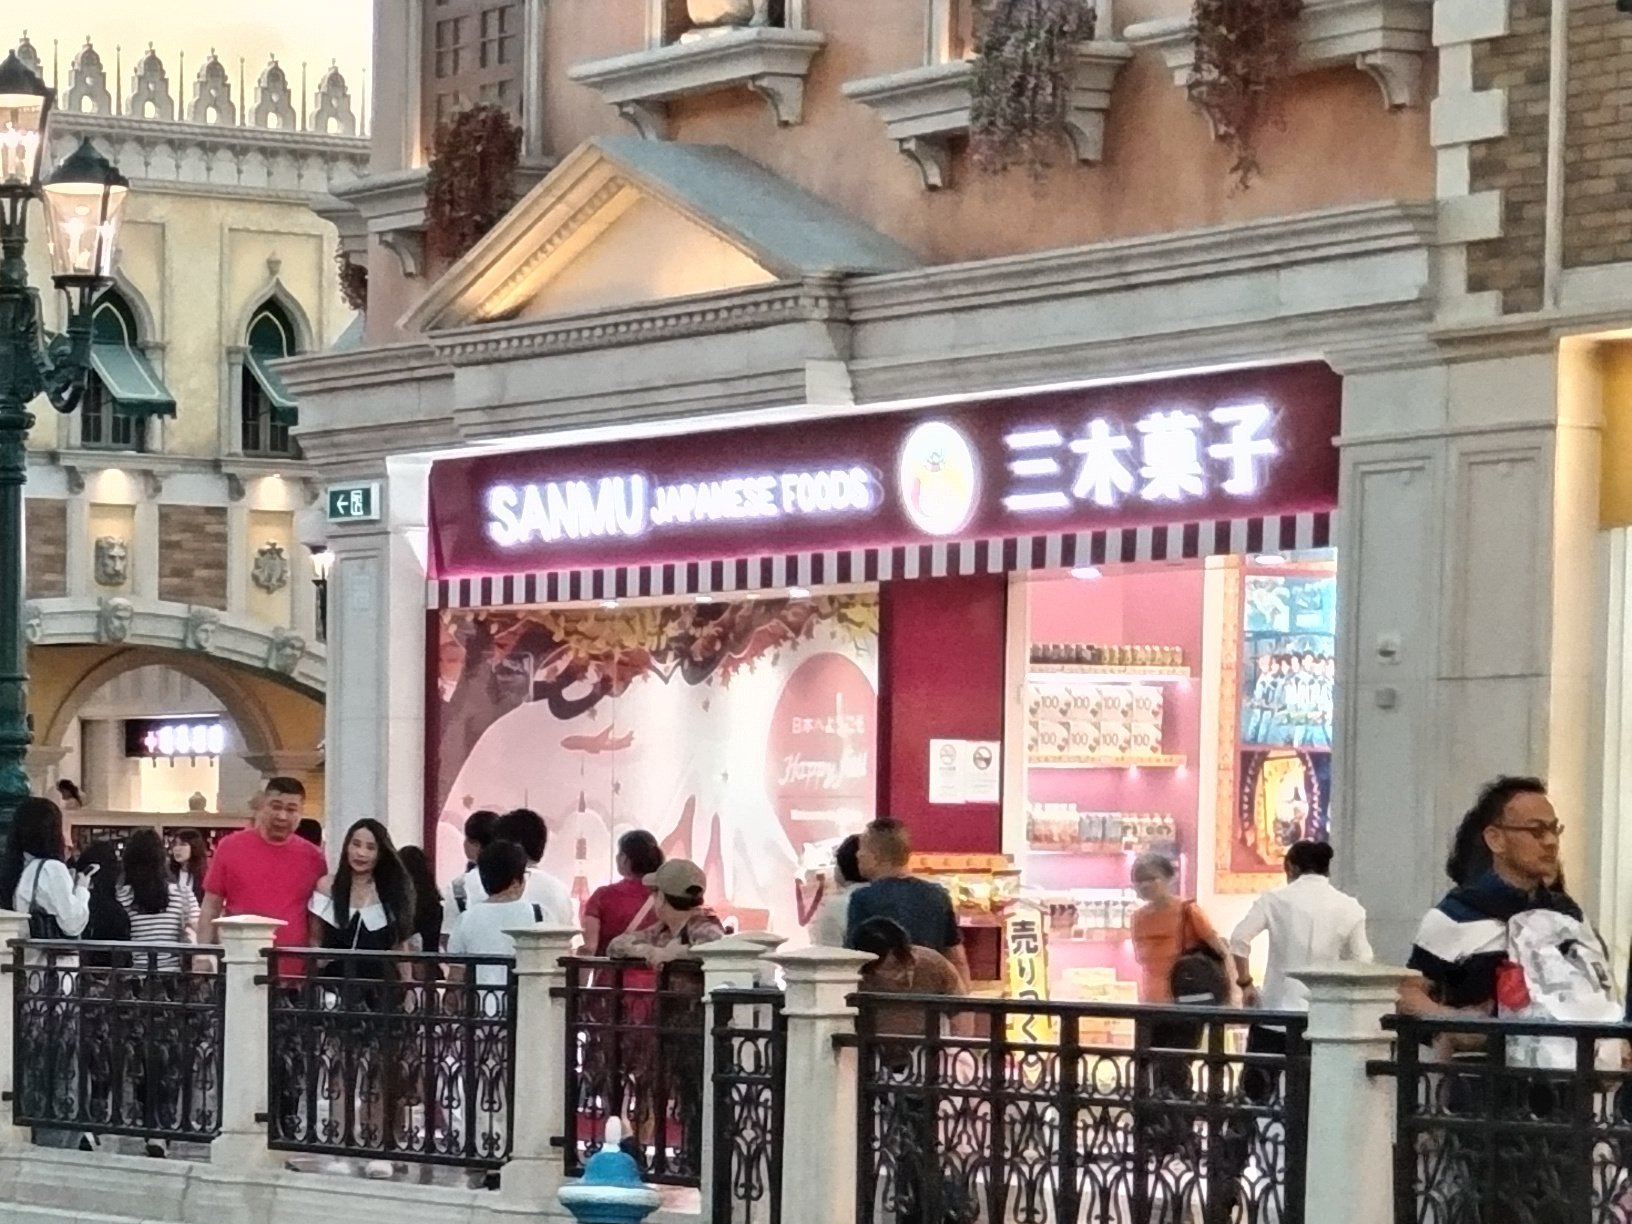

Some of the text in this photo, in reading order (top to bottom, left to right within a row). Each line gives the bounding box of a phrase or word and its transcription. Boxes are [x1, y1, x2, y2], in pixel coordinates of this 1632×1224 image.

[1002, 402, 1280, 512] 三木菓子
[488, 466, 872, 547] SANMU JAPANESE FOODS
[1040, 696, 1060, 709] 100
[1073, 696, 1090, 709] 100
[1103, 697, 1121, 710] 100
[1134, 698, 1152, 710] 100
[1040, 732, 1057, 745] 100
[1071, 732, 1089, 745] 100
[1102, 733, 1119, 746] 100
[1133, 733, 1150, 746] 100
[778, 752, 839, 791] Happy
